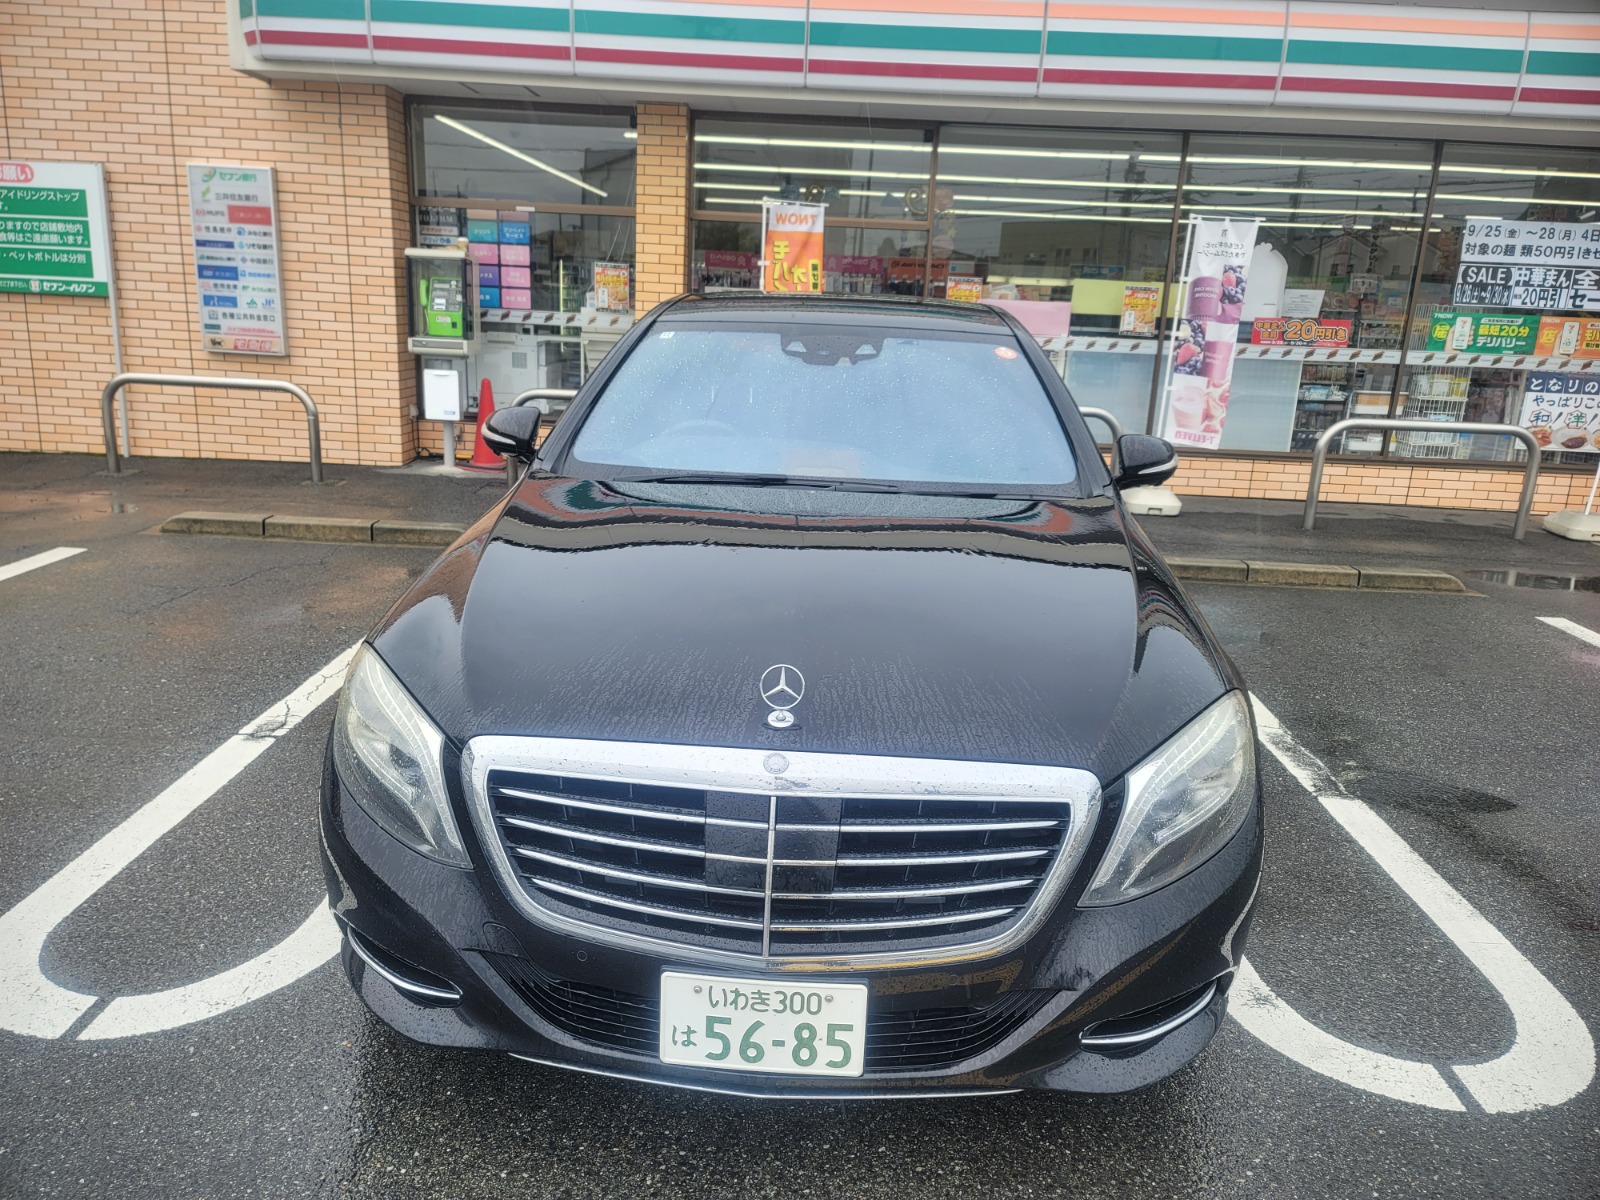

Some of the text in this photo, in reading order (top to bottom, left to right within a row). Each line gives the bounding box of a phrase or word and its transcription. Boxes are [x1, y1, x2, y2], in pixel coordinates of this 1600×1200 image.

[0, 165, 32, 180] 願い
[219, 172, 257, 182] セブン銀行
[0, 189, 79, 202] アイドリングストップ
[215, 192, 258, 202] 三井住友銀行
[1516, 267, 1570, 287] 中華まん
[1478, 324, 1530, 337] 最短20分
[1476, 336, 1527, 348] デリバリー
[671, 1015, 854, 1069] は 56-85
